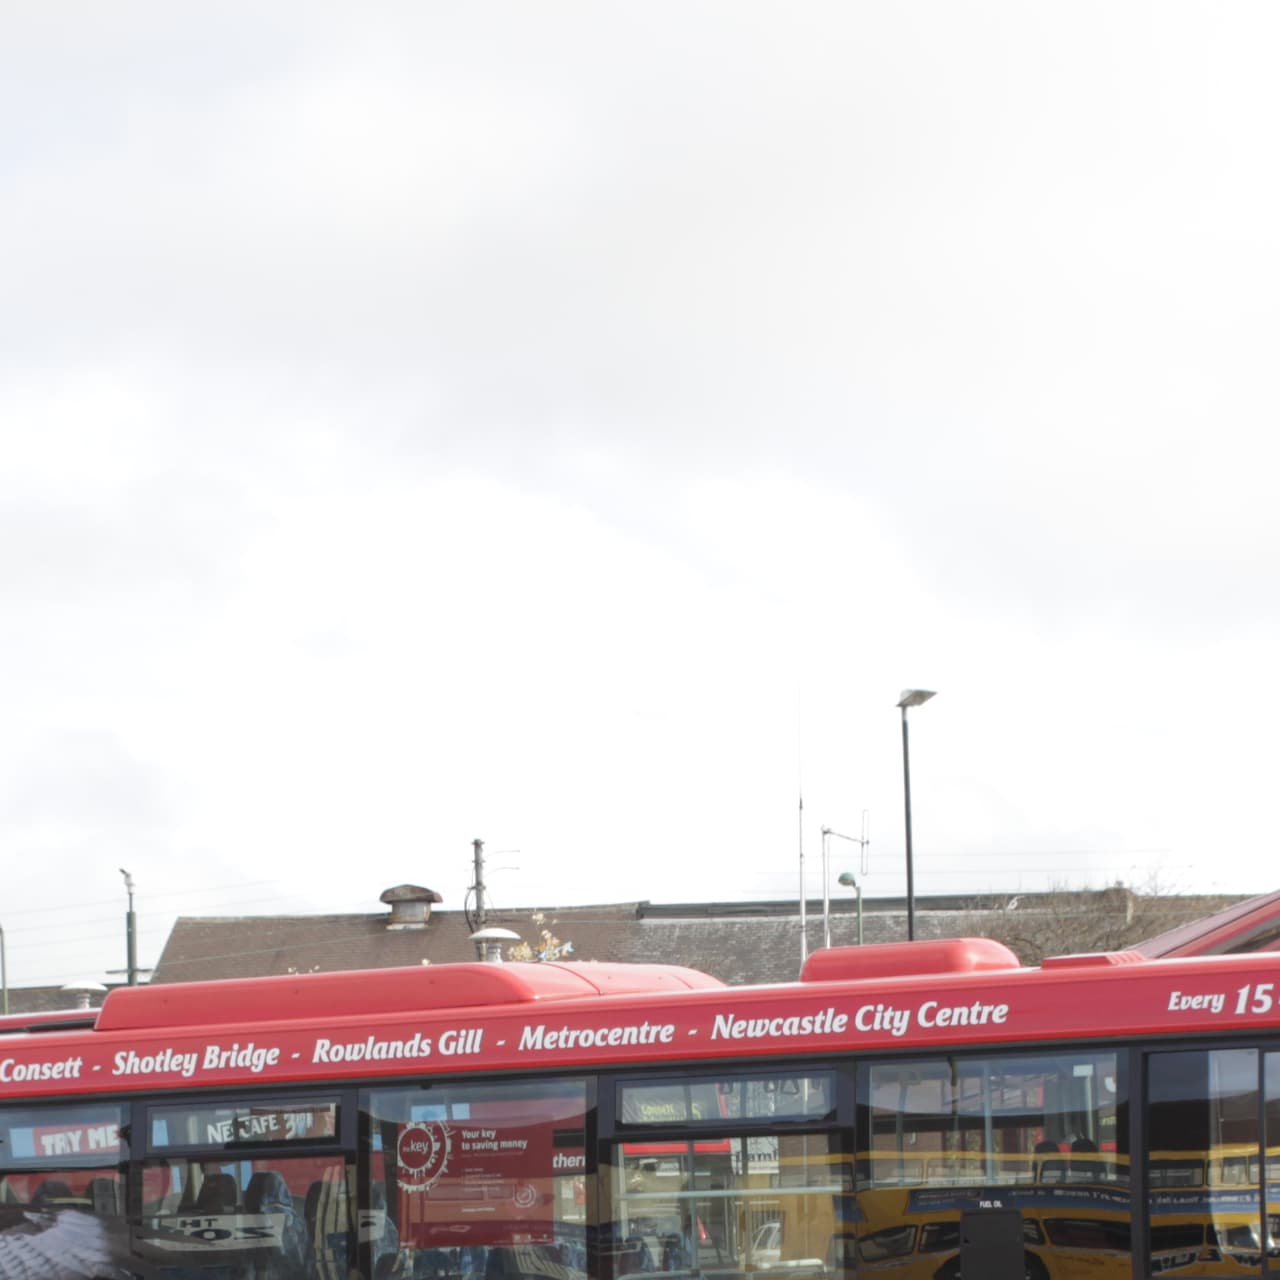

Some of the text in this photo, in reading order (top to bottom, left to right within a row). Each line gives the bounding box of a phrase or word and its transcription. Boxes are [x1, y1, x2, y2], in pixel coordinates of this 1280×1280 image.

[1167, 990, 1225, 1013] Every
[1234, 983, 1274, 1014] 15
[111, 1048, 197, 1077] Shotley
[202, 1042, 280, 1073] Bridge
[312, 1033, 431, 1063] Rowlands
[438, 1028, 483, 1055] Gill
[518, 1020, 675, 1050] Metrocentre
[710, 1007, 847, 1040] Newcastle
[855, 1003, 911, 1037] City
[917, 1000, 1009, 1029] Centre
[41, 1124, 121, 1156] TRY ME
[461, 1139, 527, 1152] to saving money
[462, 1128, 496, 1140] Your key
[411, 1138, 429, 1155] key
